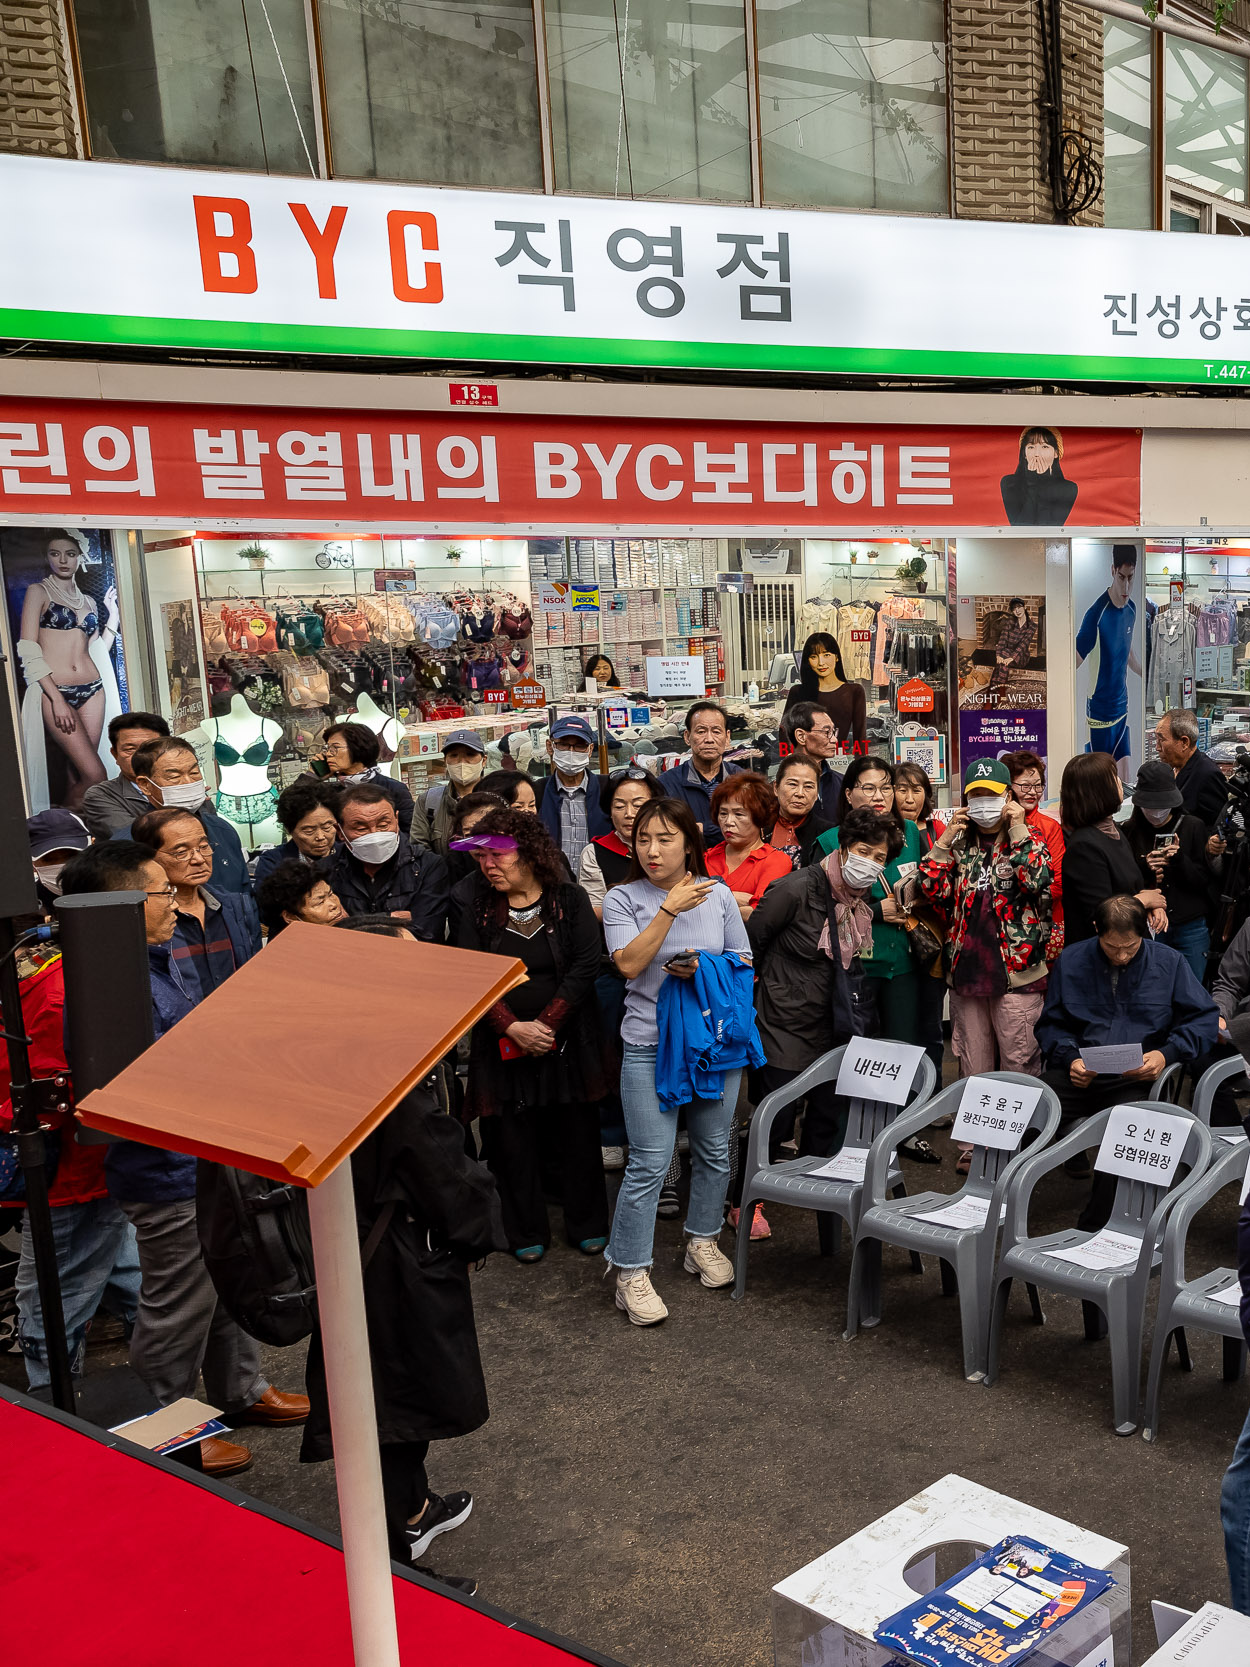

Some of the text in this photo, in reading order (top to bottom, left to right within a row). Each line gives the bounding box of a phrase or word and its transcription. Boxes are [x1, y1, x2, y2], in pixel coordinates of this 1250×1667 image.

[193, 195, 793, 323] BYC 직영점
[461, 385, 480, 400] 13
[193, 428, 501, 503] 발열내의
[533, 441, 955, 509] BYC보디히트
[575, 596, 596, 604] NSOK
[852, 631, 869, 641] BYC
[487, 693, 505, 702] BYC
[963, 692, 1042, 704] NIGHT WEAR
[980, 726, 1000, 735] 귀여운
[1003, 734, 1038, 743] 만나보세요!
[974, 762, 993, 778] A's
[853, 1057, 902, 1082] 내빈석
[962, 1111, 1026, 1134] 광진구의회 의장
[1112, 1143, 1172, 1170] 당협위원장
[934, 1620, 1011, 1664] 맥주 페스티벌
